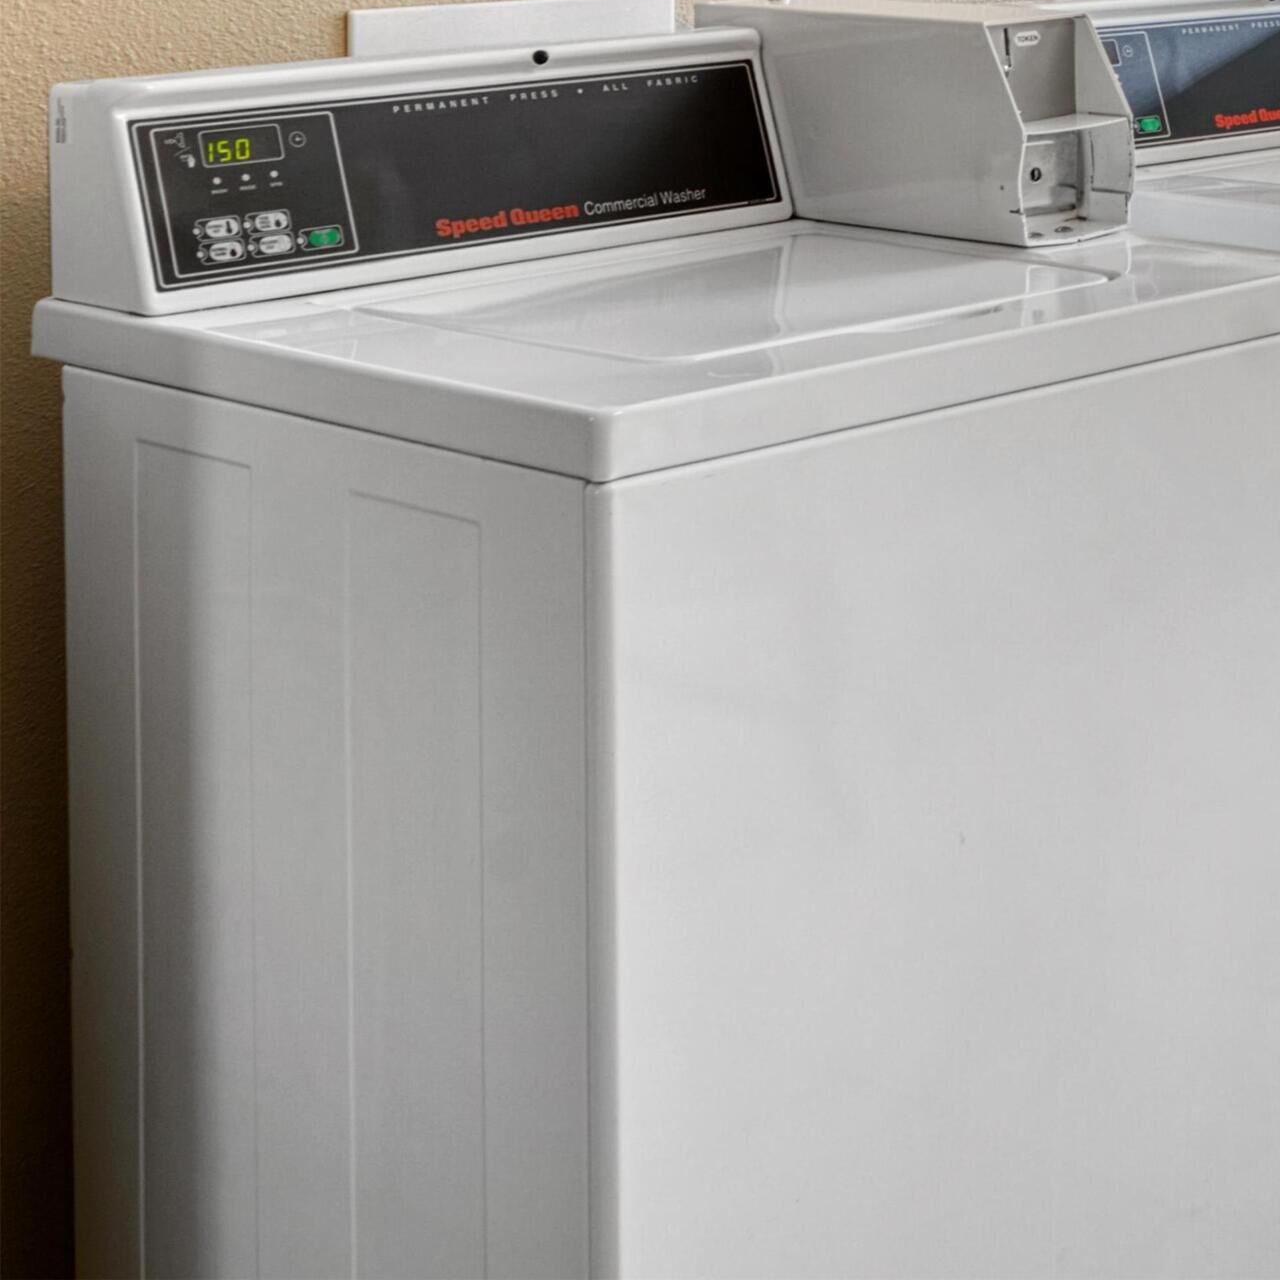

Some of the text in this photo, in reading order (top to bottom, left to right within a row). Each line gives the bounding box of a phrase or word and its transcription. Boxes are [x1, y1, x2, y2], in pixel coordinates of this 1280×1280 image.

[1182, 24, 1240, 34] PERMANENT
[1251, 20, 1280, 29] PRESS
[392, 75, 699, 114] PERMANENT PRESS ALL FABRIC
[1215, 111, 1257, 129] Speed
[208, 139, 250, 163] 150
[435, 187, 707, 238] Speed Queen Commercial Washer
